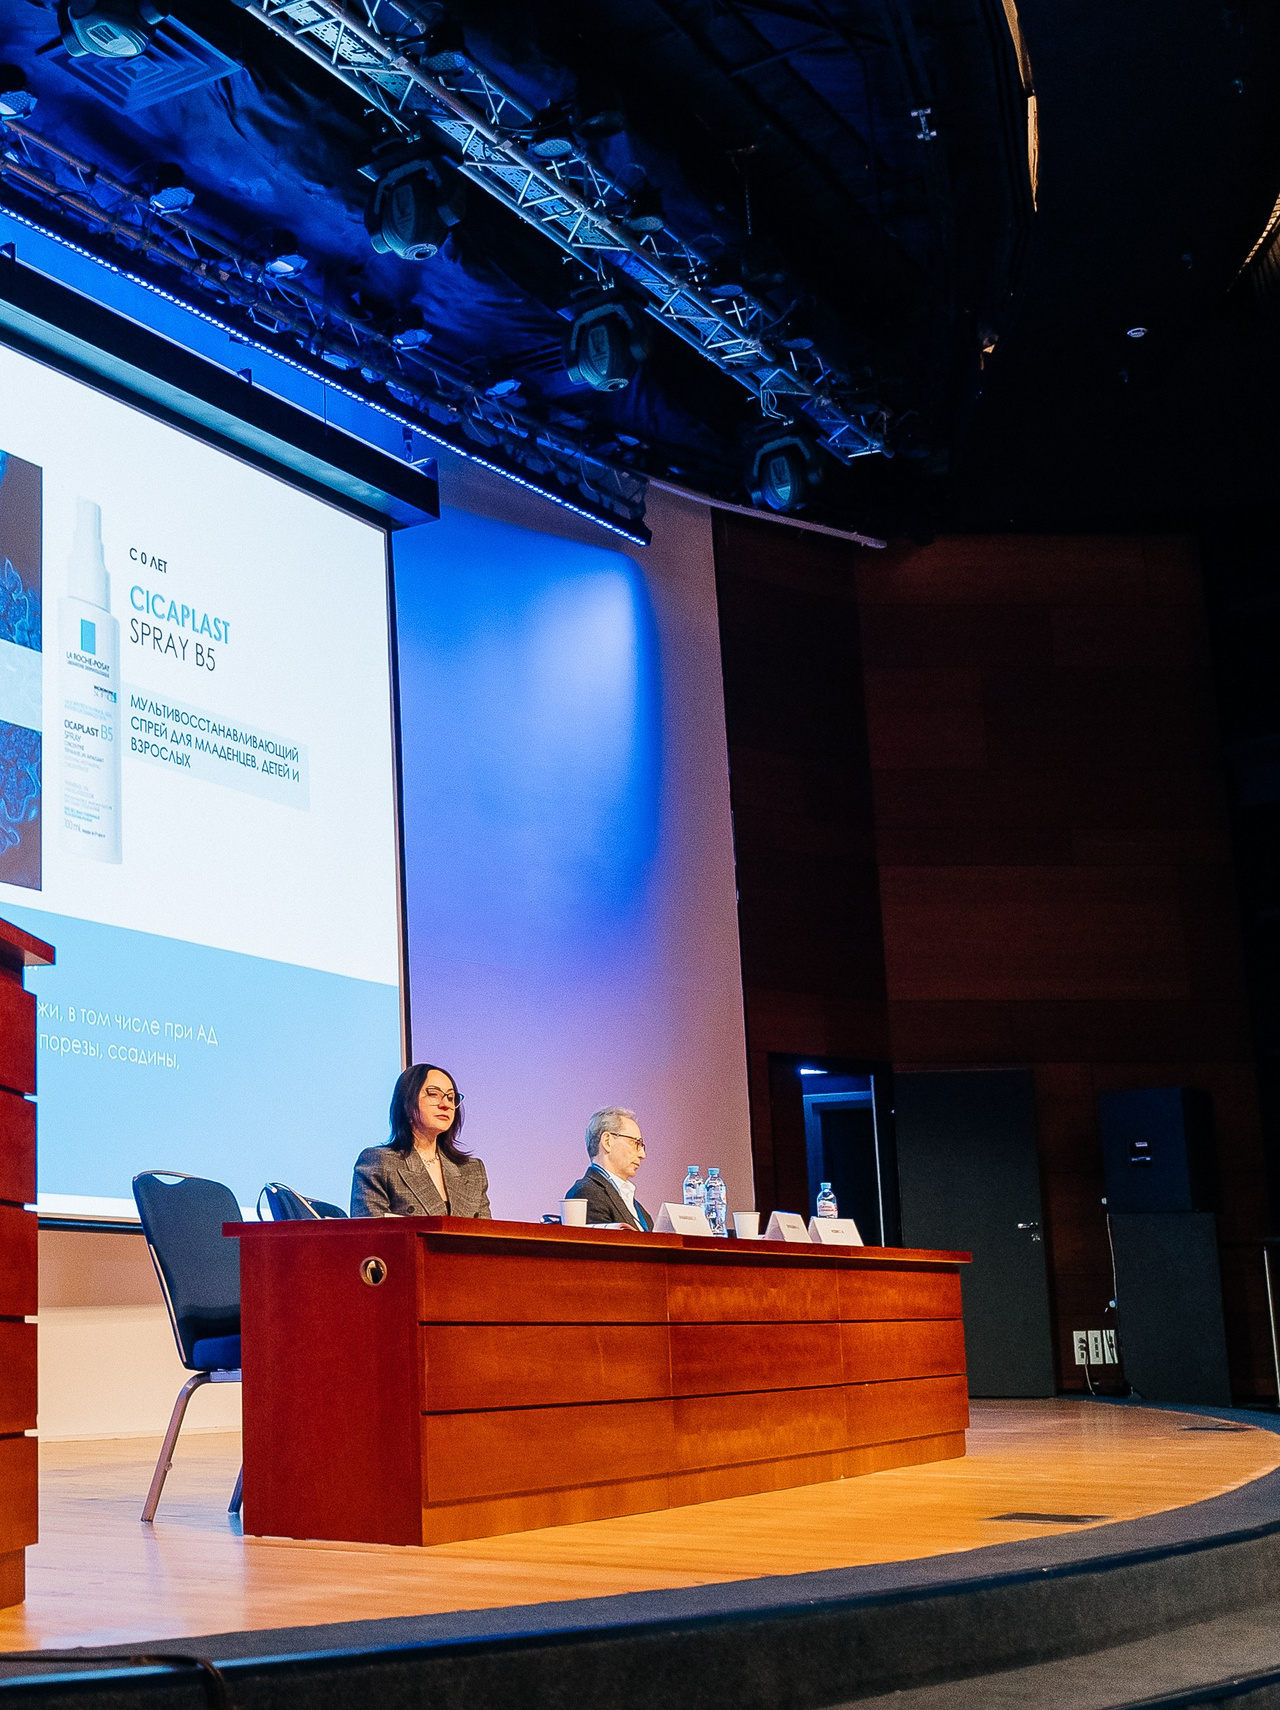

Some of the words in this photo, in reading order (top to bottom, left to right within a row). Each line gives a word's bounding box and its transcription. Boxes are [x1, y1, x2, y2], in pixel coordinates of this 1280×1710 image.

[150, 556, 168, 573] ЛЕТ
[130, 585, 230, 644] CICAPLAST
[130, 618, 189, 661] SPRAY
[196, 642, 216, 672] B5
[100, 724, 113, 742] B5
[130, 694, 299, 763] МУЛЬТИВОССТАНАВЛИВАЮЩИЙ
[131, 716, 167, 740] СПРЕЙ
[170, 729, 192, 748] ДЛЯ
[195, 737, 259, 771] МЛАДЕНЦЕВ,
[262, 759, 290, 780] ДЕТЕЙ
[292, 770, 300, 783] И
[131, 737, 191, 768] ВЗРОСЛЫХ
[37, 1001, 63, 1022] жи,
[69, 1006, 76, 1022] в
[80, 1008, 111, 1028] том
[115, 1015, 160, 1036] числе
[164, 1022, 193, 1042] при
[196, 1024, 219, 1046] АД
[39, 1033, 104, 1060] порезы,
[107, 1044, 180, 1070] ссадины,
